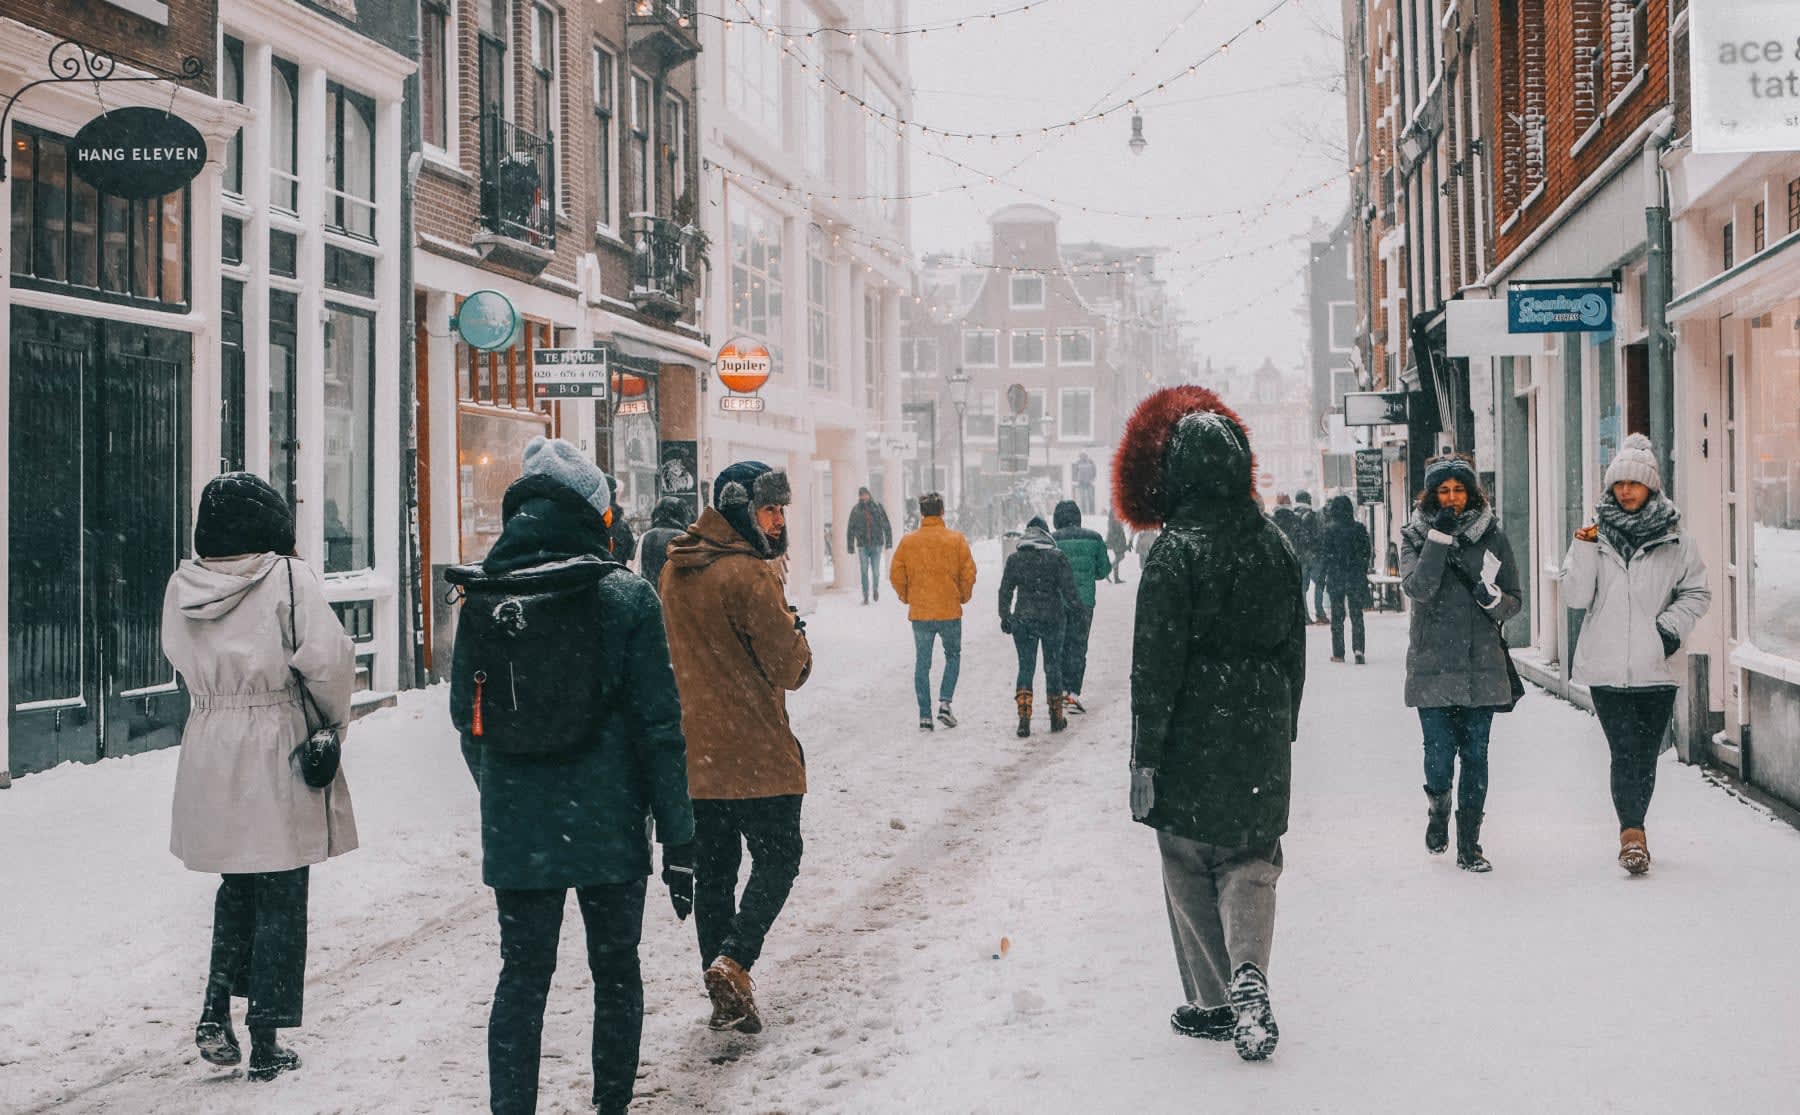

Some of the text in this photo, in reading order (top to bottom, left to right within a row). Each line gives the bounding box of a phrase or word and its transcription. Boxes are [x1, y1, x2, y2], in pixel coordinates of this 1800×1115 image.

[1718, 41, 1783, 64] ace
[1749, 69, 1799, 98] tat
[78, 147, 198, 161] HANG ELEVEN
[543, 353, 559, 363] TE
[720, 359, 766, 373] Jupiler
[724, 399, 735, 409] DE
